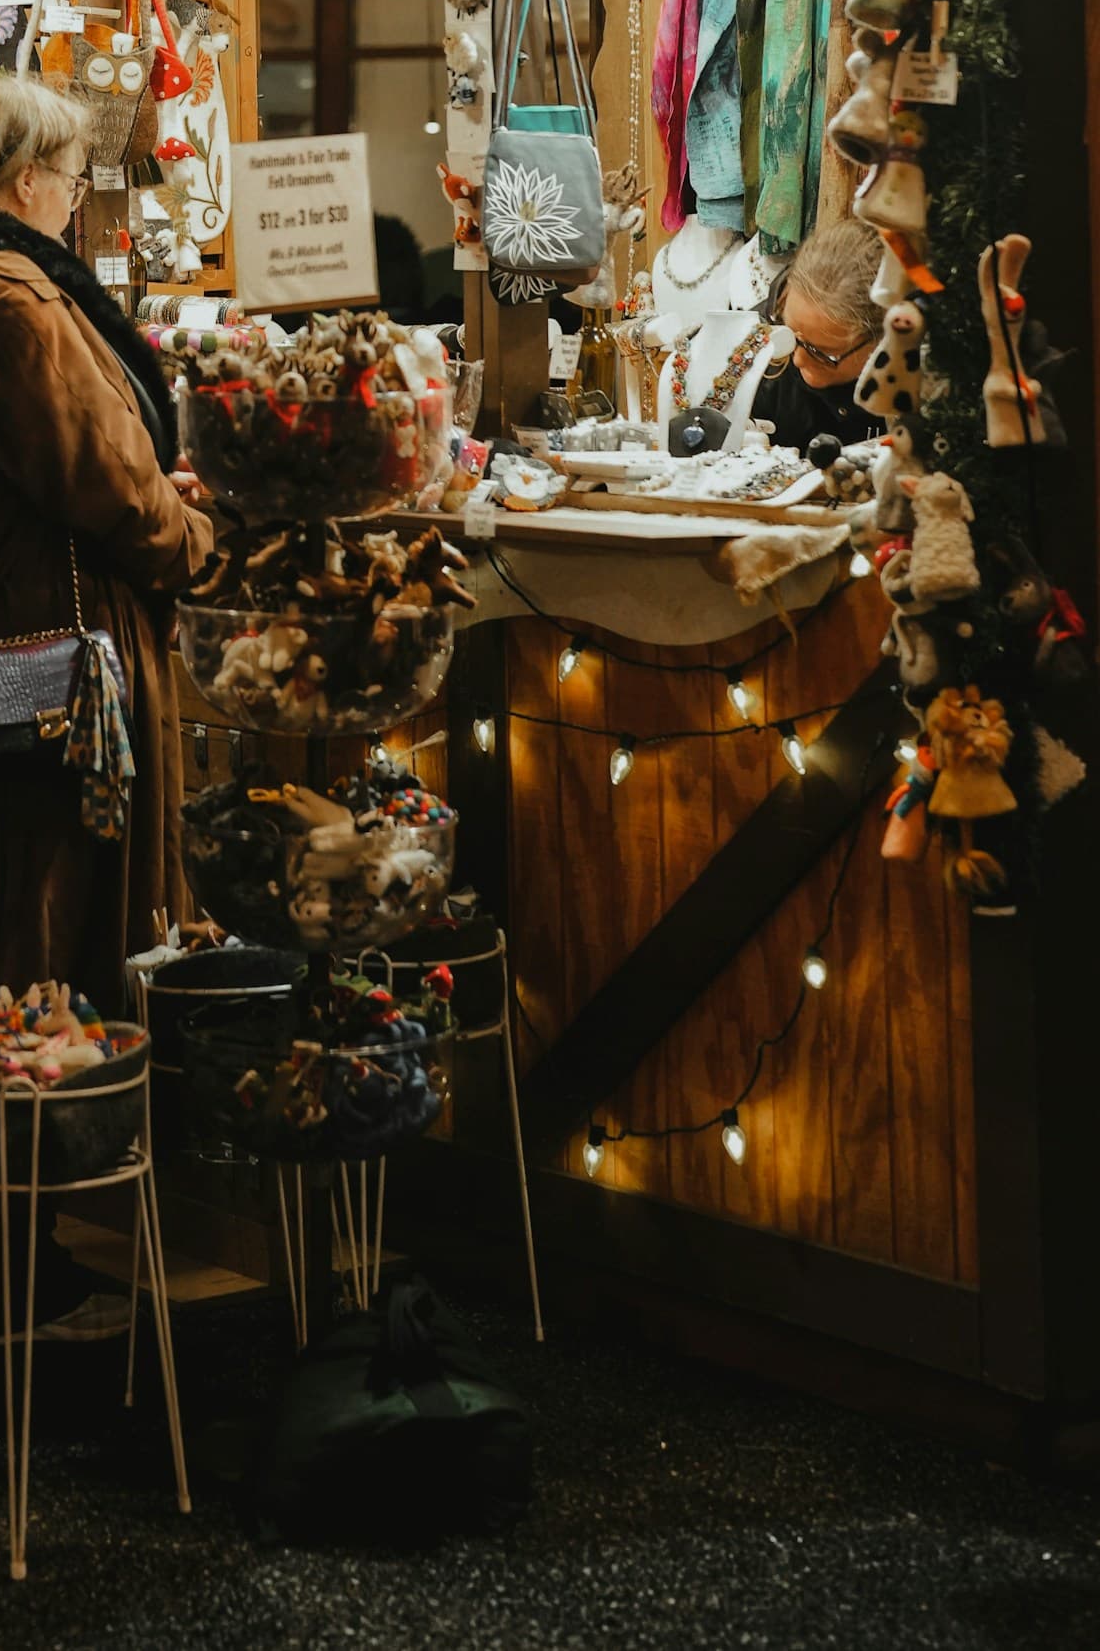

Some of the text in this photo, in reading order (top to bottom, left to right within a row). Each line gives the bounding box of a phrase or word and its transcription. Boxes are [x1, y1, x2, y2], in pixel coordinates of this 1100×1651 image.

[250, 149, 351, 169] Handmade & Fair Trade
[268, 172, 335, 189] Felt Ornaments
[259, 212, 280, 229] $12
[298, 209, 306, 226] 3
[309, 209, 325, 224] for
[328, 205, 348, 222] $30
